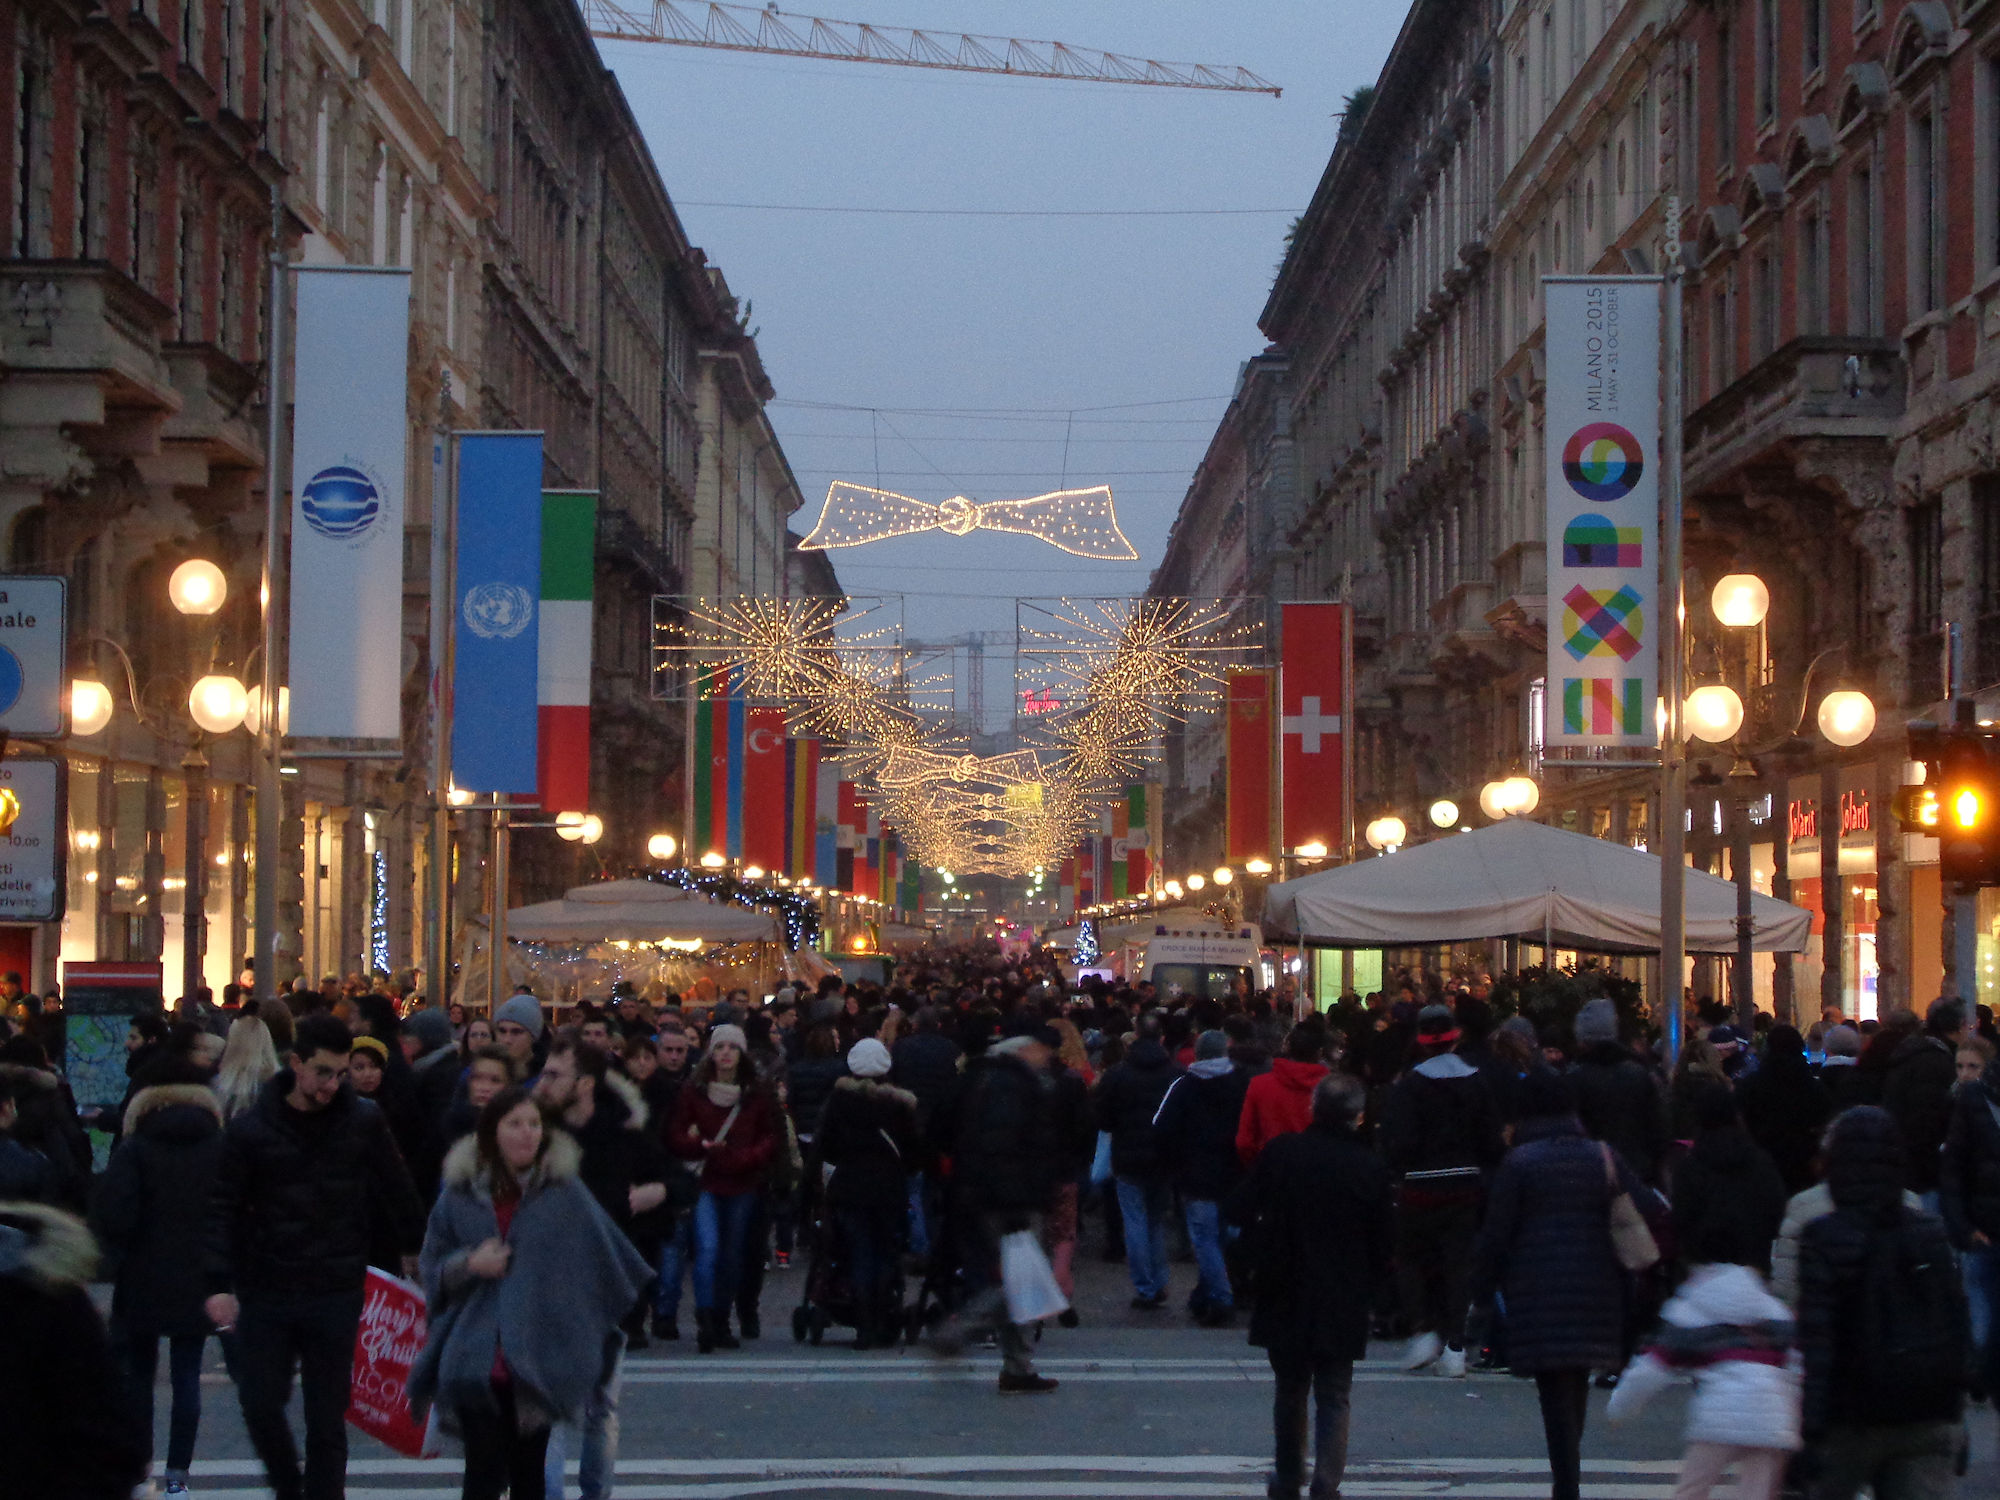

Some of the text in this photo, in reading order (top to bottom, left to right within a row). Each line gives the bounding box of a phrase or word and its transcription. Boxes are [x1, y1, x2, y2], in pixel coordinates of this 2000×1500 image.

[1607, 287, 1619, 349] OCTOBER
[1586, 287, 1603, 412] MILANO 2015
[1607, 352, 1619, 365] 31
[1607, 377, 1619, 402] MAY
[1562, 421, 1644, 736] EXPO
[0, 611, 36, 628] ale
[1788, 799, 1815, 845] Solaris
[1840, 789, 1870, 837] Solaris
